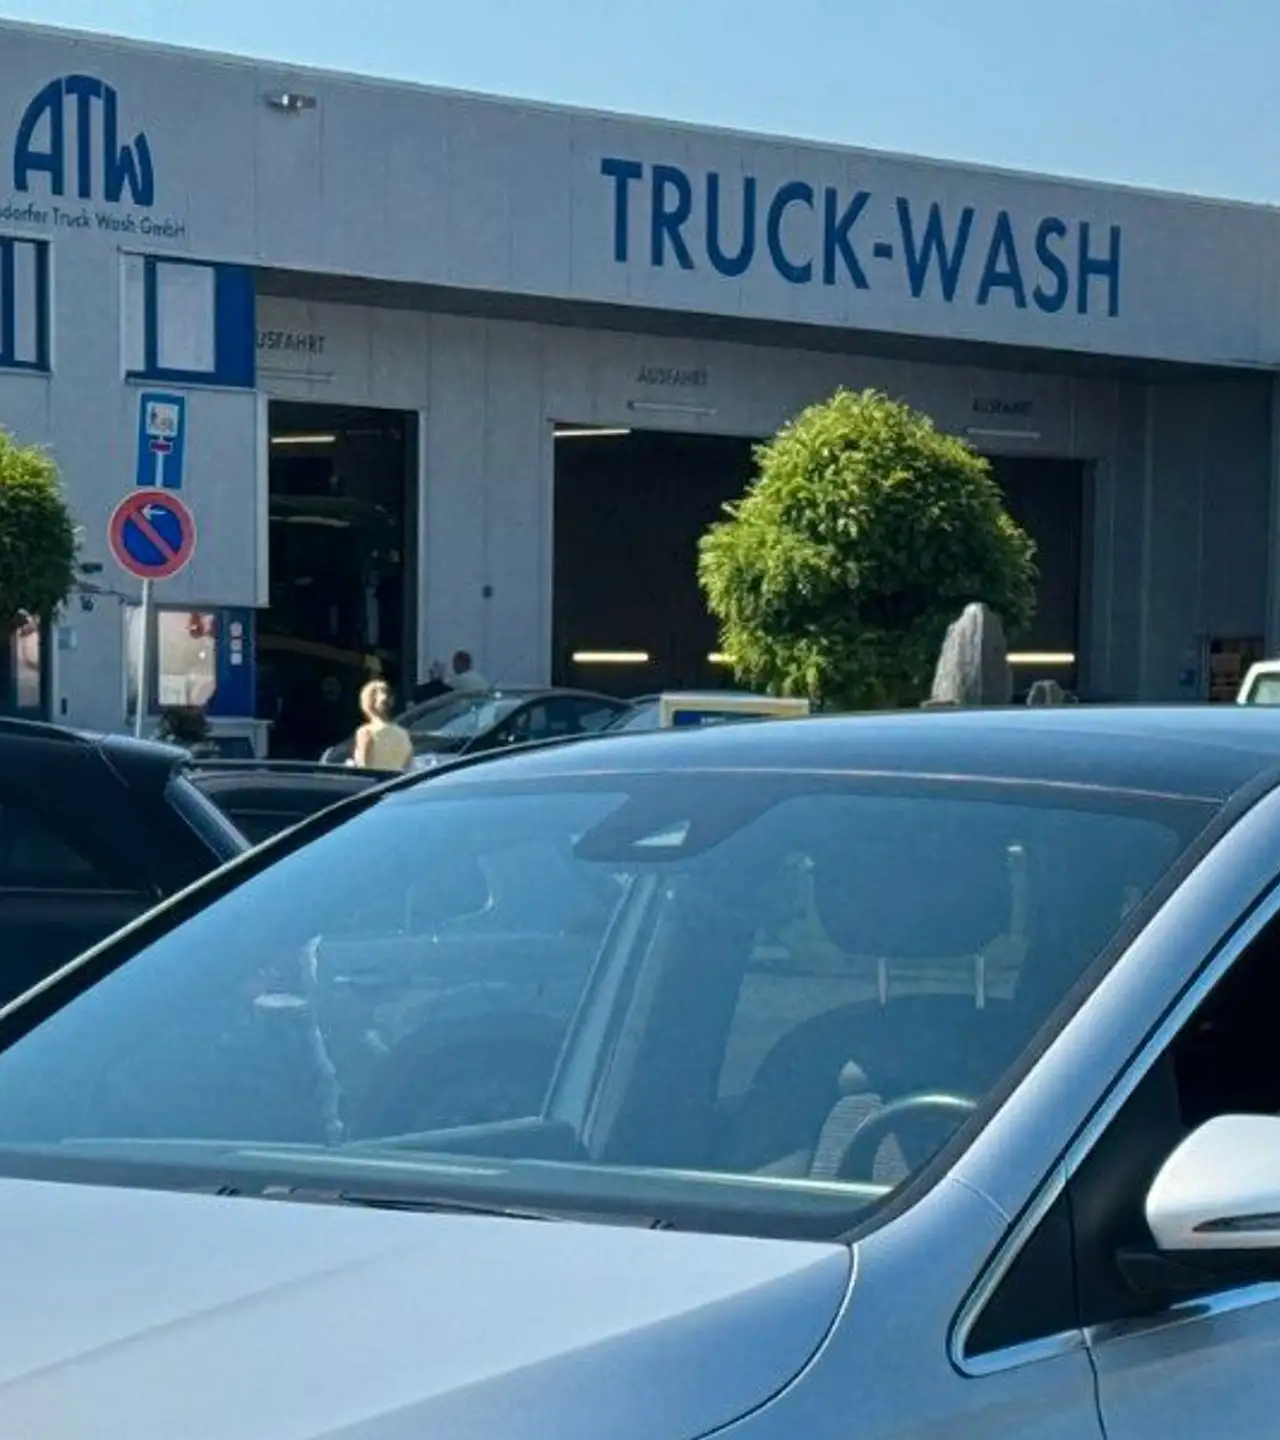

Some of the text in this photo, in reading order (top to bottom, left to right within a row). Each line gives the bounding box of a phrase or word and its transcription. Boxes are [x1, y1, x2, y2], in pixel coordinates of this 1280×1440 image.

[13, 74, 155, 206] ATW
[53, 206, 89, 229] Truck
[601, 157, 1121, 317] TRUCK-WASH
